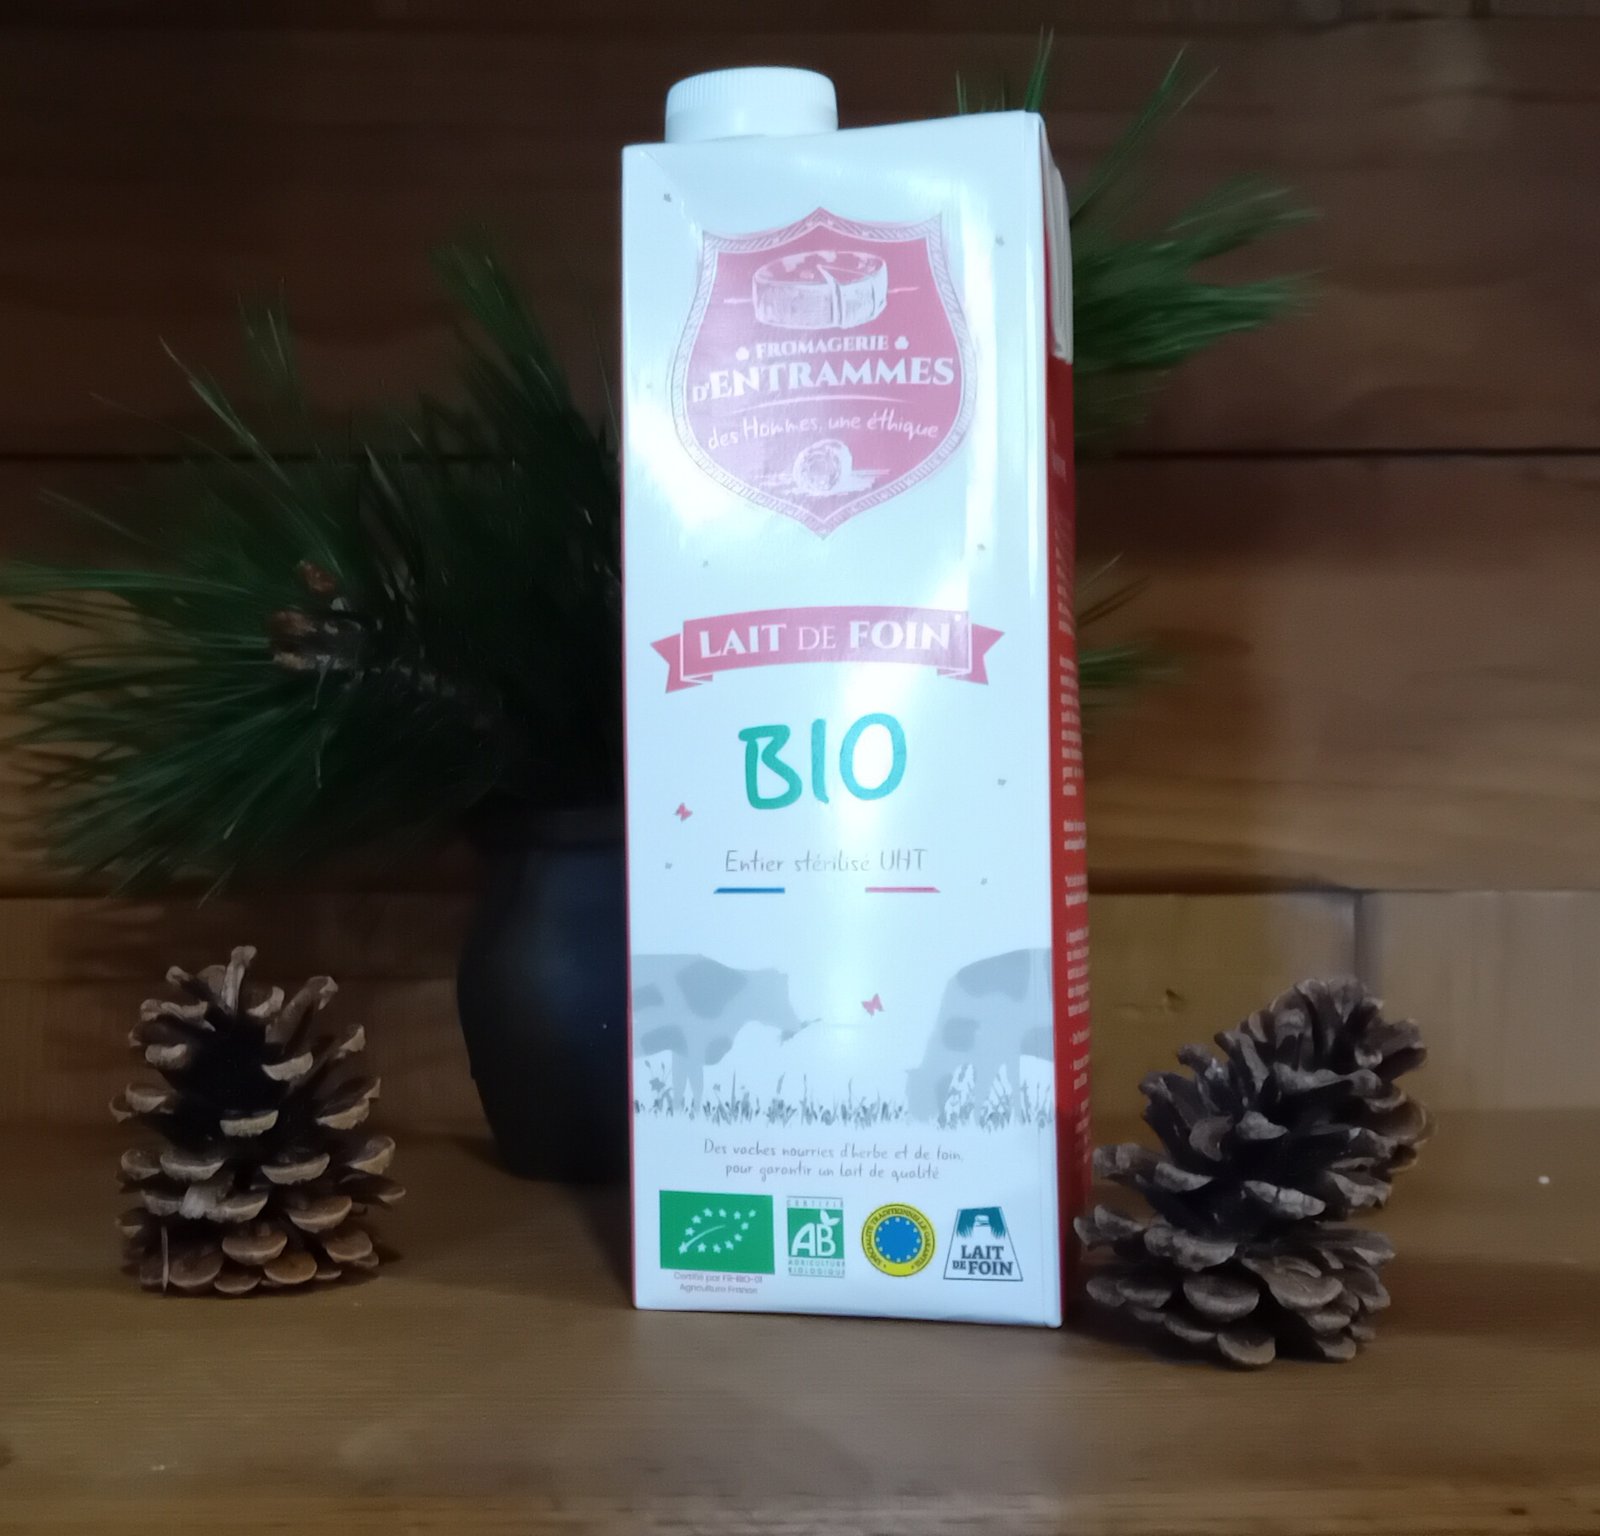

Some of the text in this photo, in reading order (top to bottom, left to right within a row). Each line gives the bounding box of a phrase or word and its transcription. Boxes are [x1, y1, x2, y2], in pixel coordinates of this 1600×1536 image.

[755, 335, 889, 359] FROMAGERIE
[692, 357, 954, 403] D'ENTRAMMES
[708, 427, 739, 450] des
[828, 414, 861, 430] une
[866, 407, 939, 441] éthique
[700, 623, 787, 659] LAIT
[798, 626, 836, 651] DE
[738, 712, 907, 810] BIO
[725, 848, 928, 873] Entier stérilisé UHT
[704, 1138, 727, 1155] Des
[733, 1141, 776, 1157] vaches
[782, 1145, 834, 1159] nourries
[840, 1143, 888, 1160] d'herbe
[894, 1143, 908, 1160] et
[914, 1144, 930, 1160] de
[725, 1160, 939, 1183] pour garantir un lait de qualité
[791, 1221, 836, 1257] AB
[961, 1244, 1004, 1260] LAIT
[952, 1260, 1014, 1276] DE FOIN
